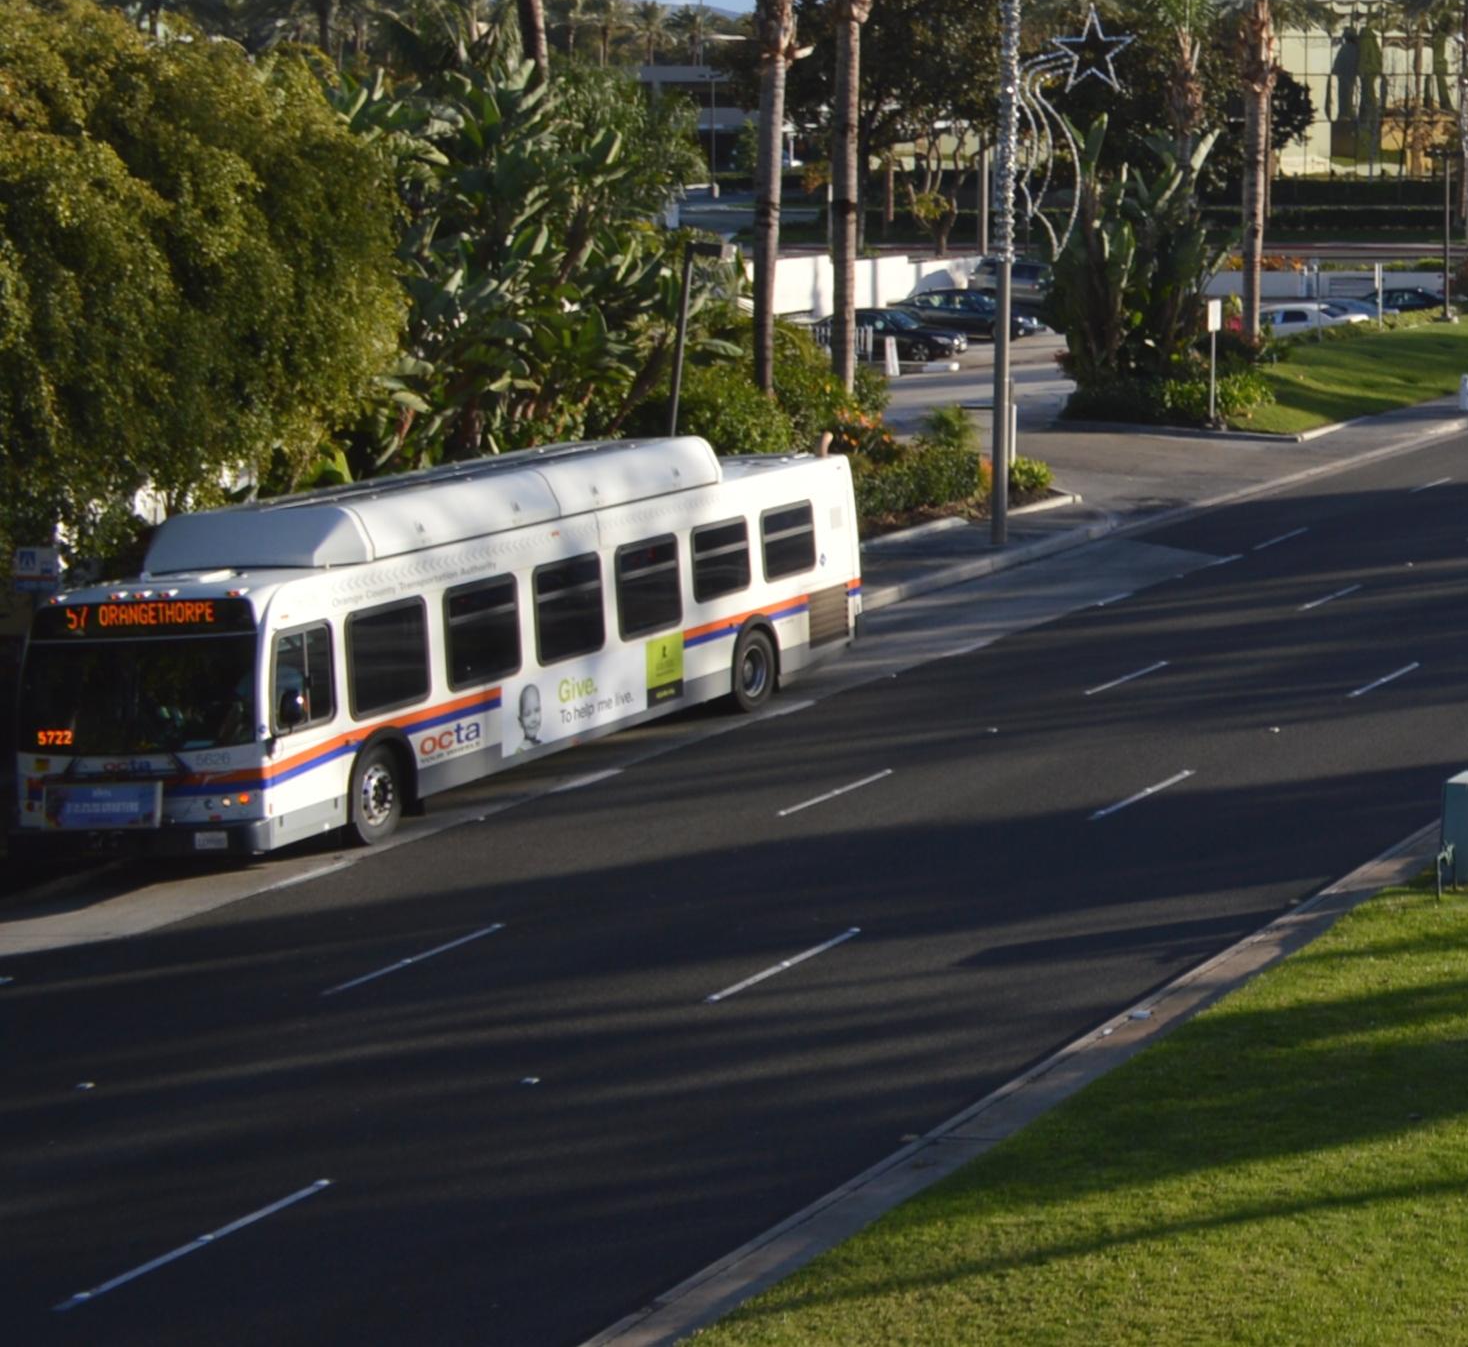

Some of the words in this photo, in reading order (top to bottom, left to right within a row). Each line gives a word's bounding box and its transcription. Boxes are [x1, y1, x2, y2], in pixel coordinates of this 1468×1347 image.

[332, 594, 363, 608] Orange
[366, 587, 396, 599] County
[400, 572, 458, 591] Transportation
[461, 562, 497, 576] Authority
[66, 606, 88, 629] 57
[98, 602, 215, 627] ORANGETHORPE
[558, 677, 598, 703] Give.
[560, 709, 572, 724] To
[574, 702, 595, 719] help
[598, 697, 613, 711] me
[615, 691, 634, 707] live.
[37, 730, 73, 746] 5722
[420, 722, 480, 755] octa
